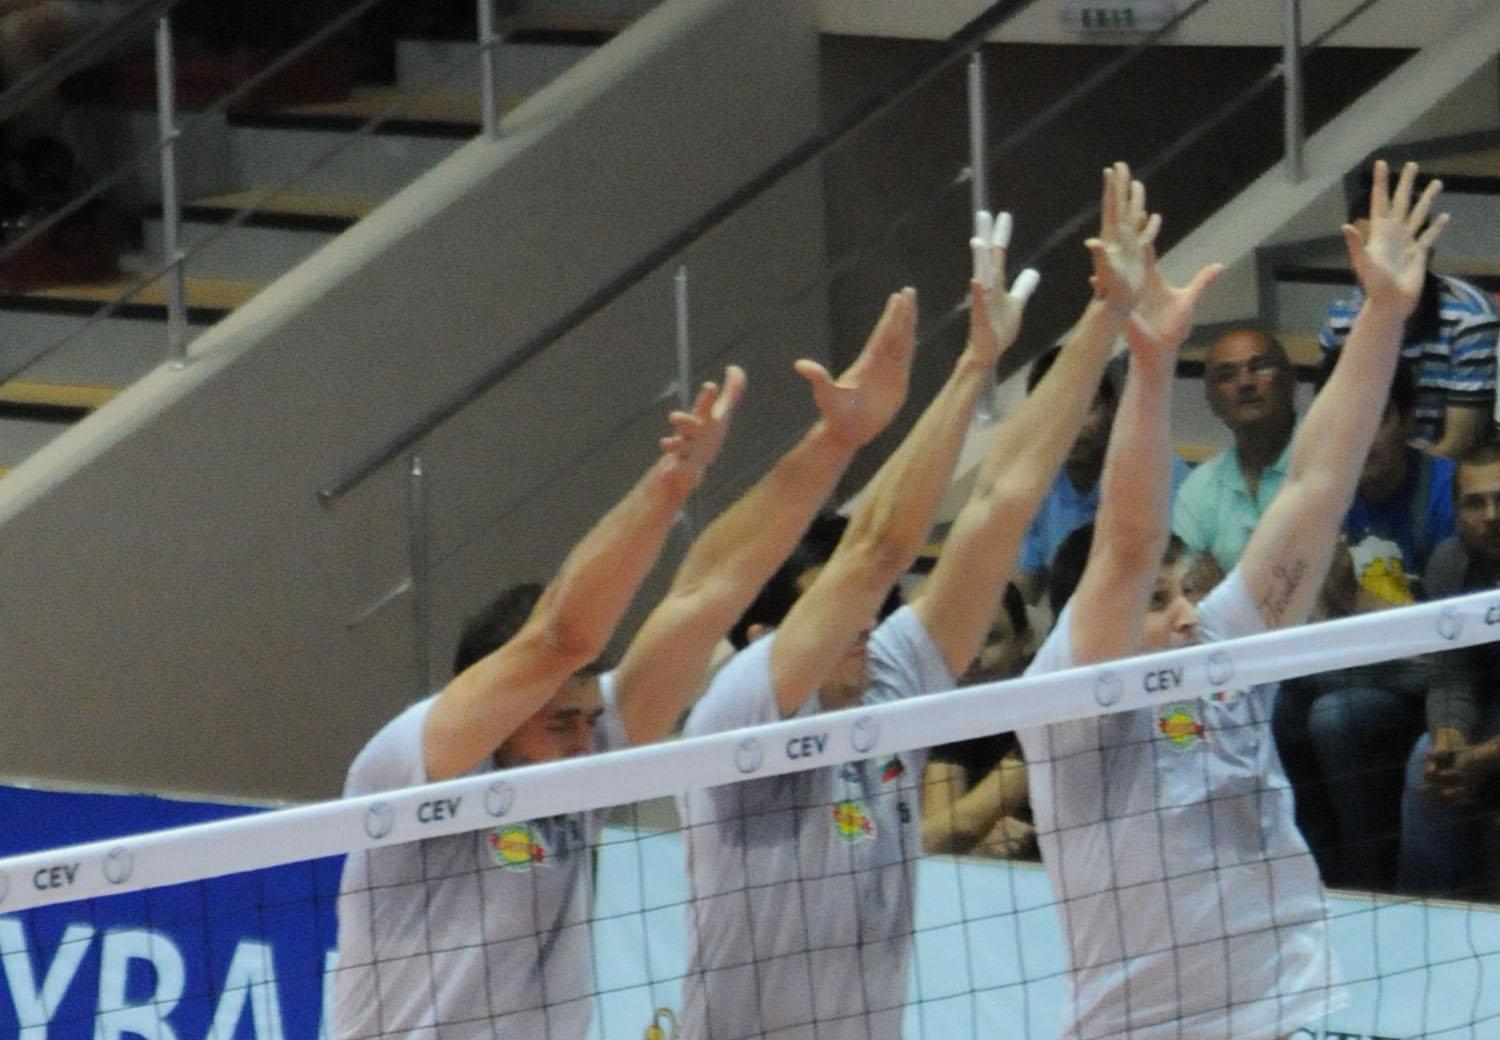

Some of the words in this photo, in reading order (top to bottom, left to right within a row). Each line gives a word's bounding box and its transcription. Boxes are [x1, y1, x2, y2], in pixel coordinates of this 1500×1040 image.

[1143, 667, 1184, 693] CEV
[786, 732, 829, 760] CEV
[417, 797, 462, 823] CEV
[33, 863, 80, 890] CEV
